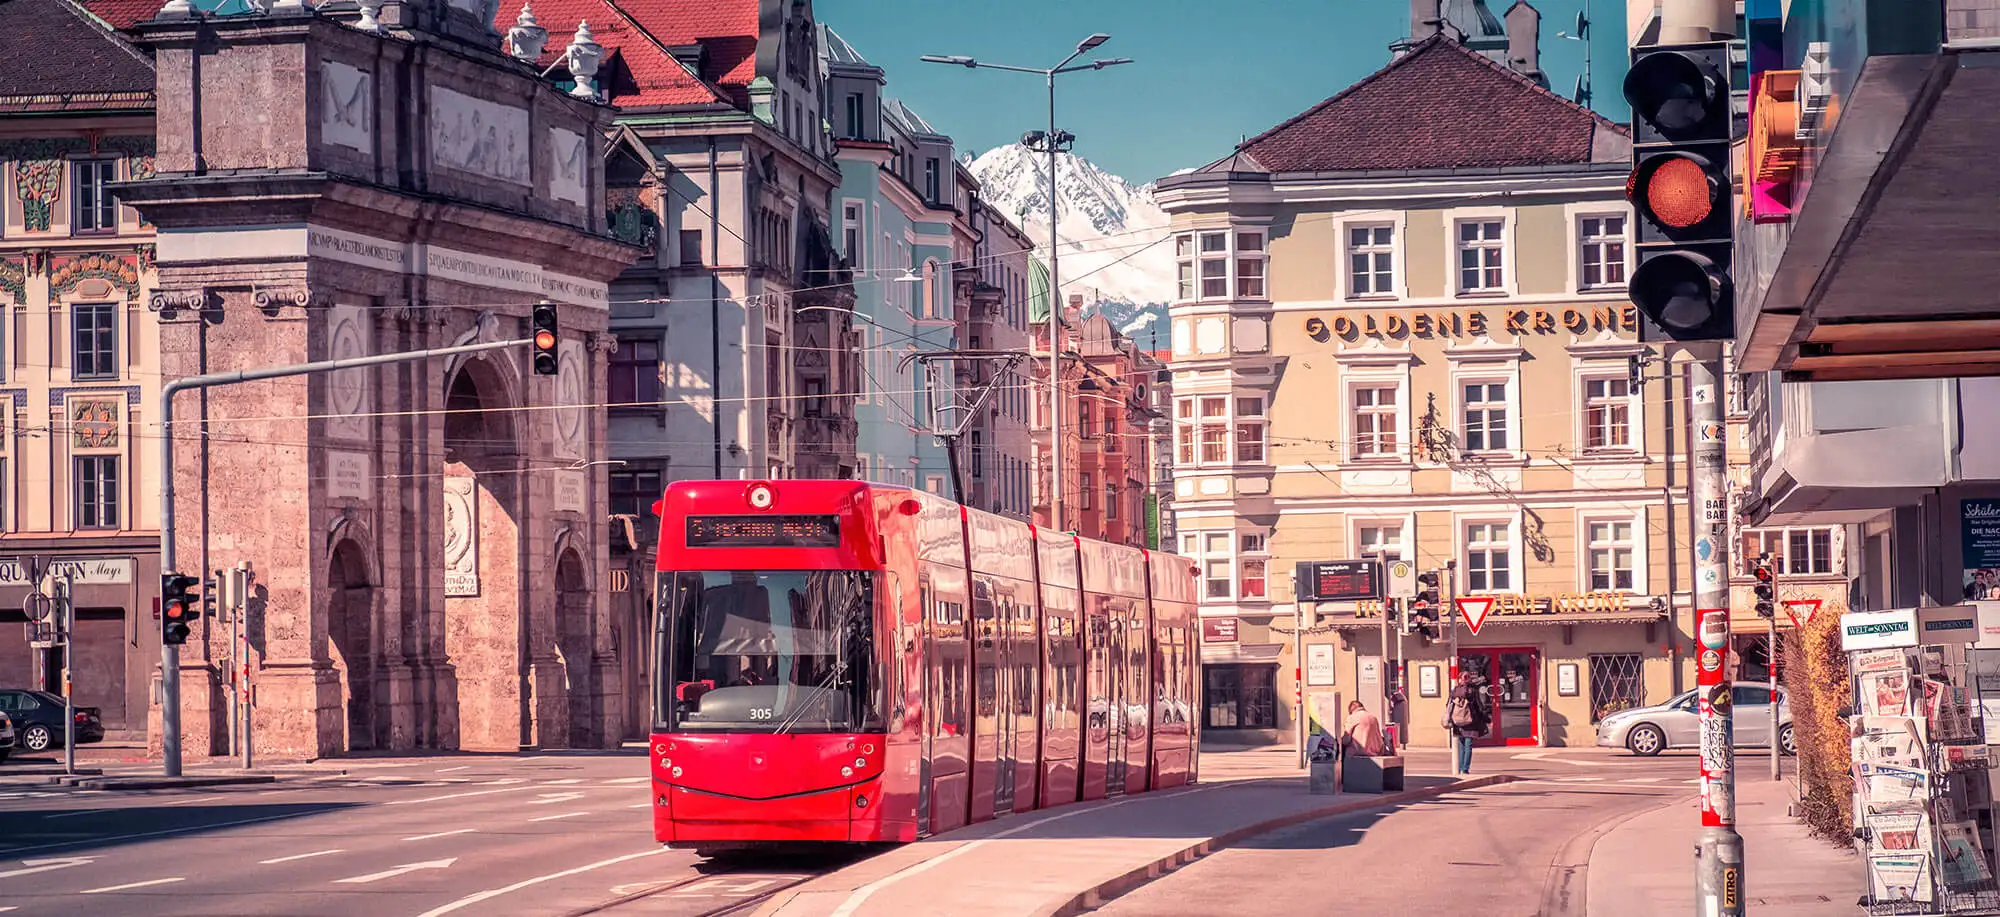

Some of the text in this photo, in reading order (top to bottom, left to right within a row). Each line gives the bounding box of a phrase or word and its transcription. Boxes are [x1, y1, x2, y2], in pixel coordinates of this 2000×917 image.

[1304, 305, 1637, 336] GOLDENE KRONE
[1551, 590, 1631, 613] KRONE
[1849, 626, 1867, 635] WELT
[1874, 622, 1908, 633] SONNTAG
[750, 708, 772, 720] 305
